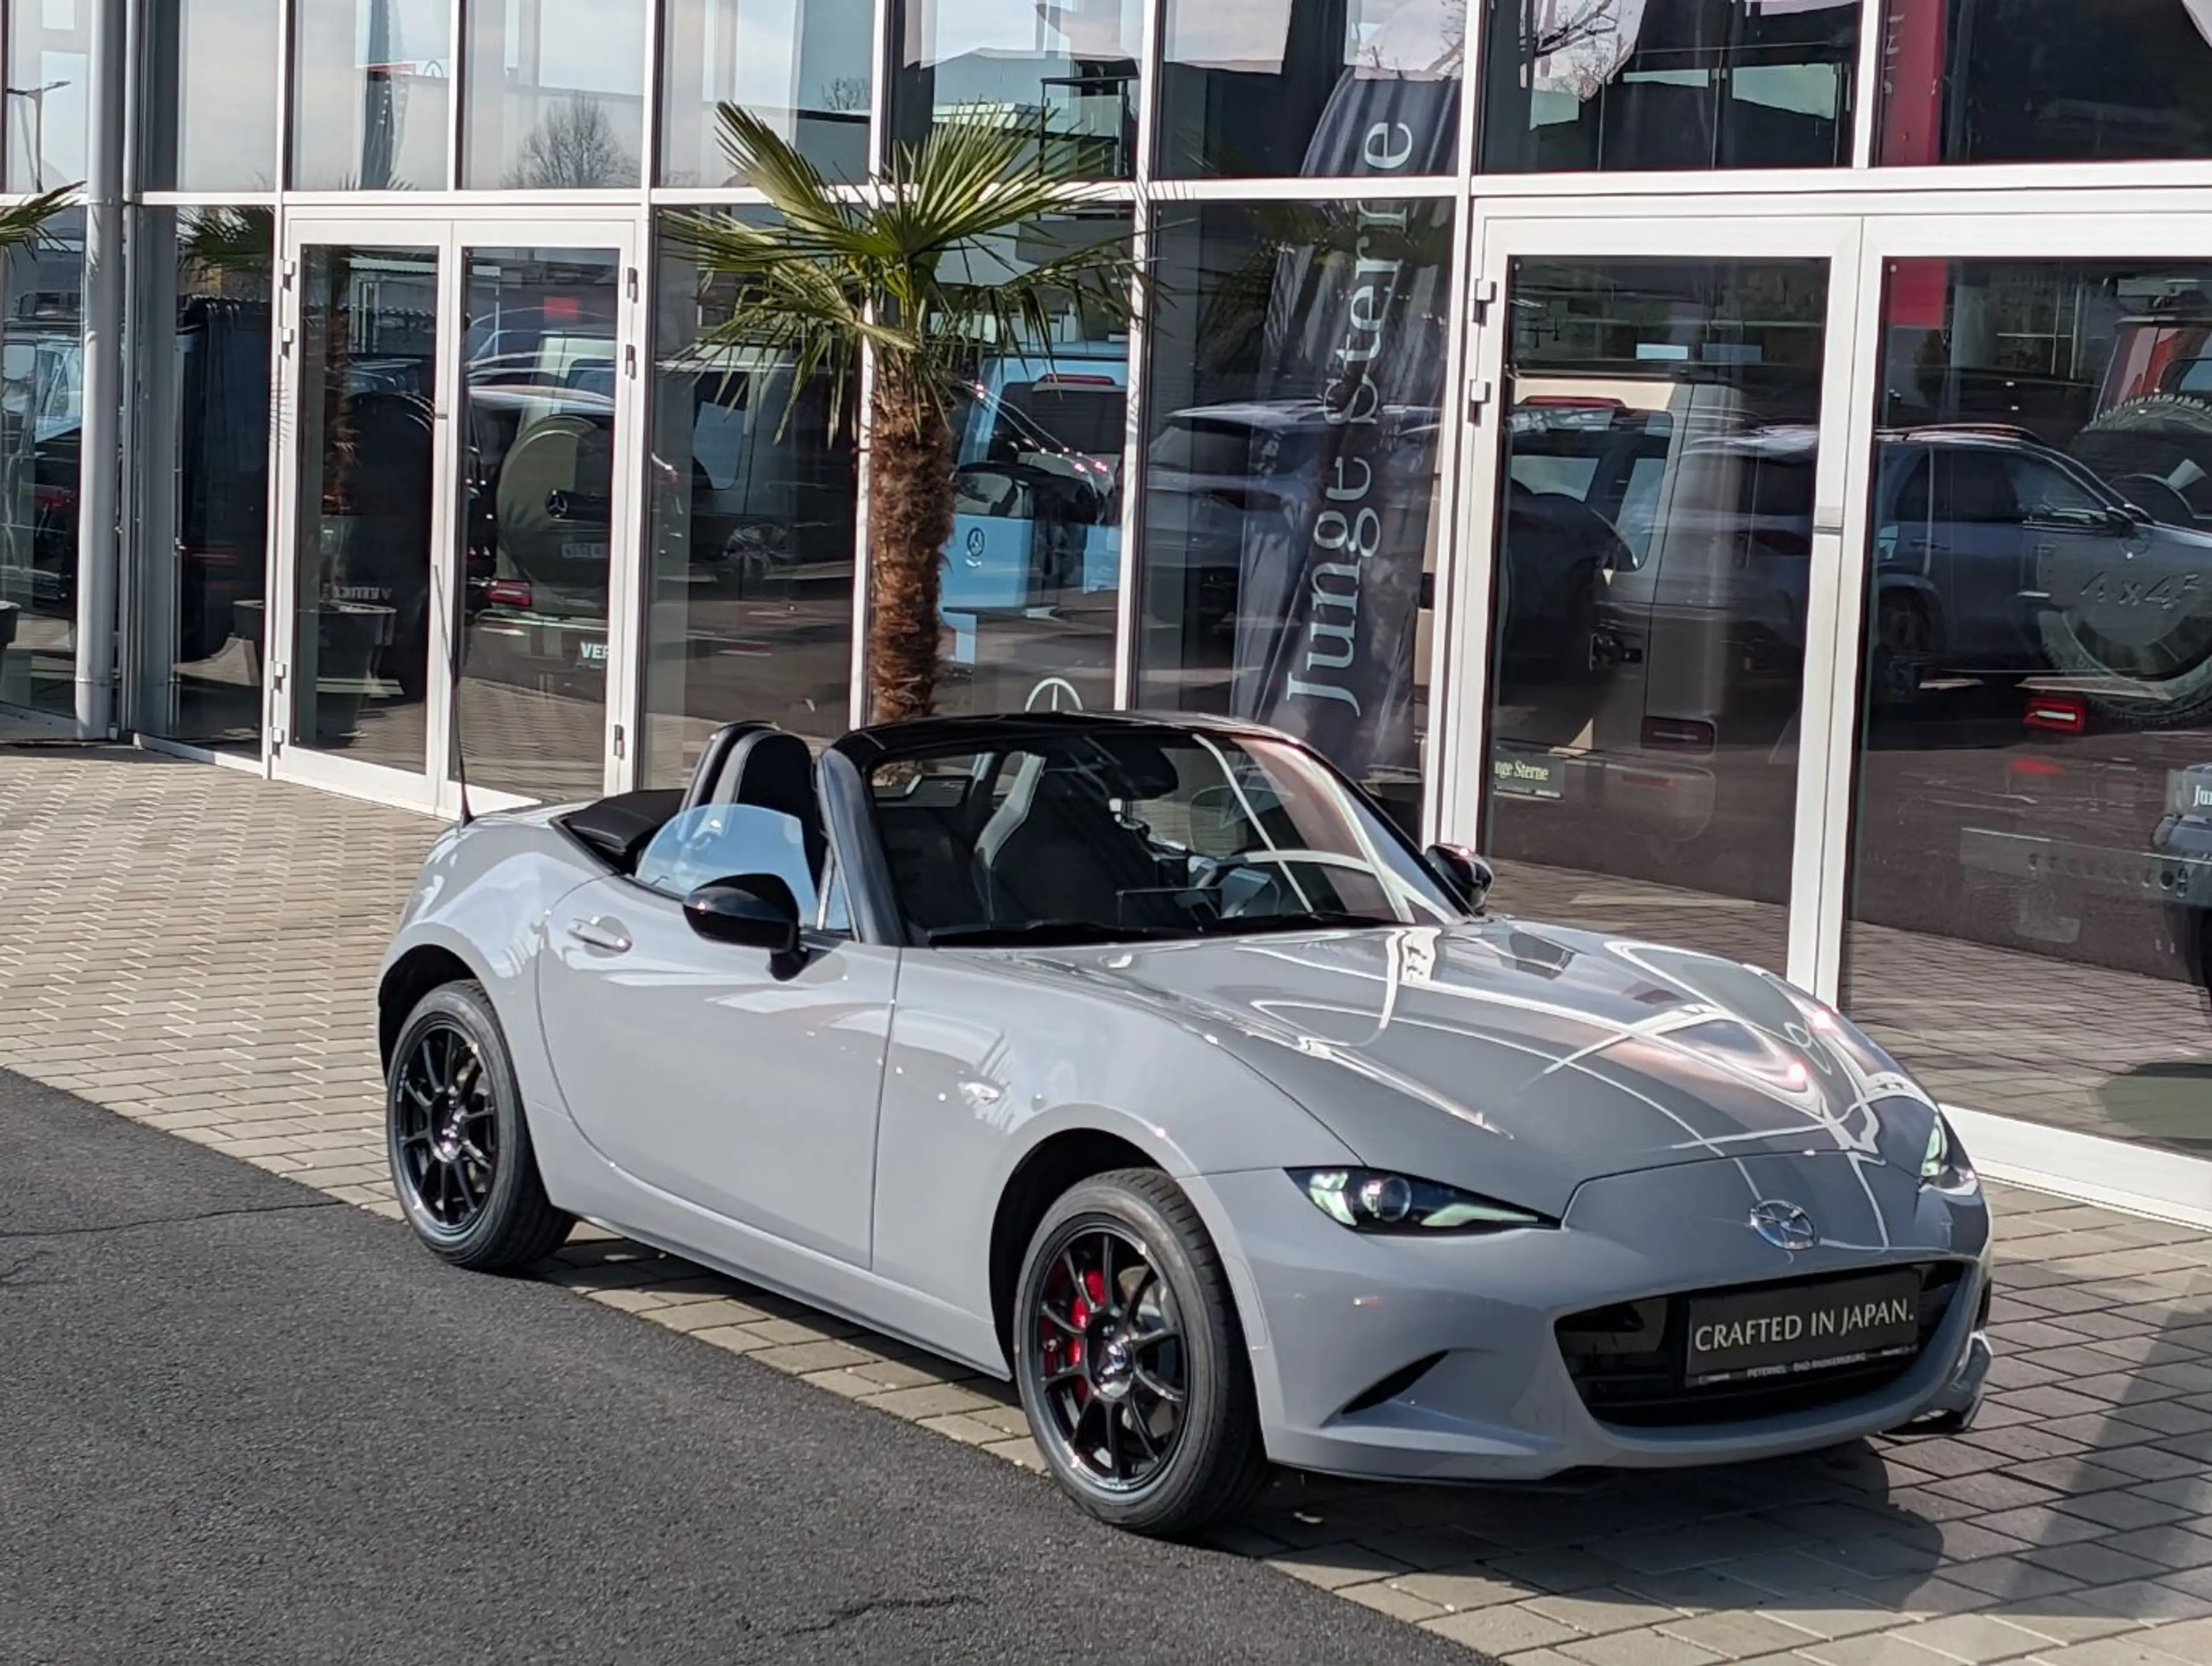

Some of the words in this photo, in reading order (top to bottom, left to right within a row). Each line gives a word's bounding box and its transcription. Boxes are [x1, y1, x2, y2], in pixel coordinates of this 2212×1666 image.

[1287, 456, 1380, 716] Junge
[1695, 1315, 1802, 1352] CRAFTED
[1810, 1310, 1835, 1336] IN
[1840, 1298, 1915, 1337] JAPAN.
